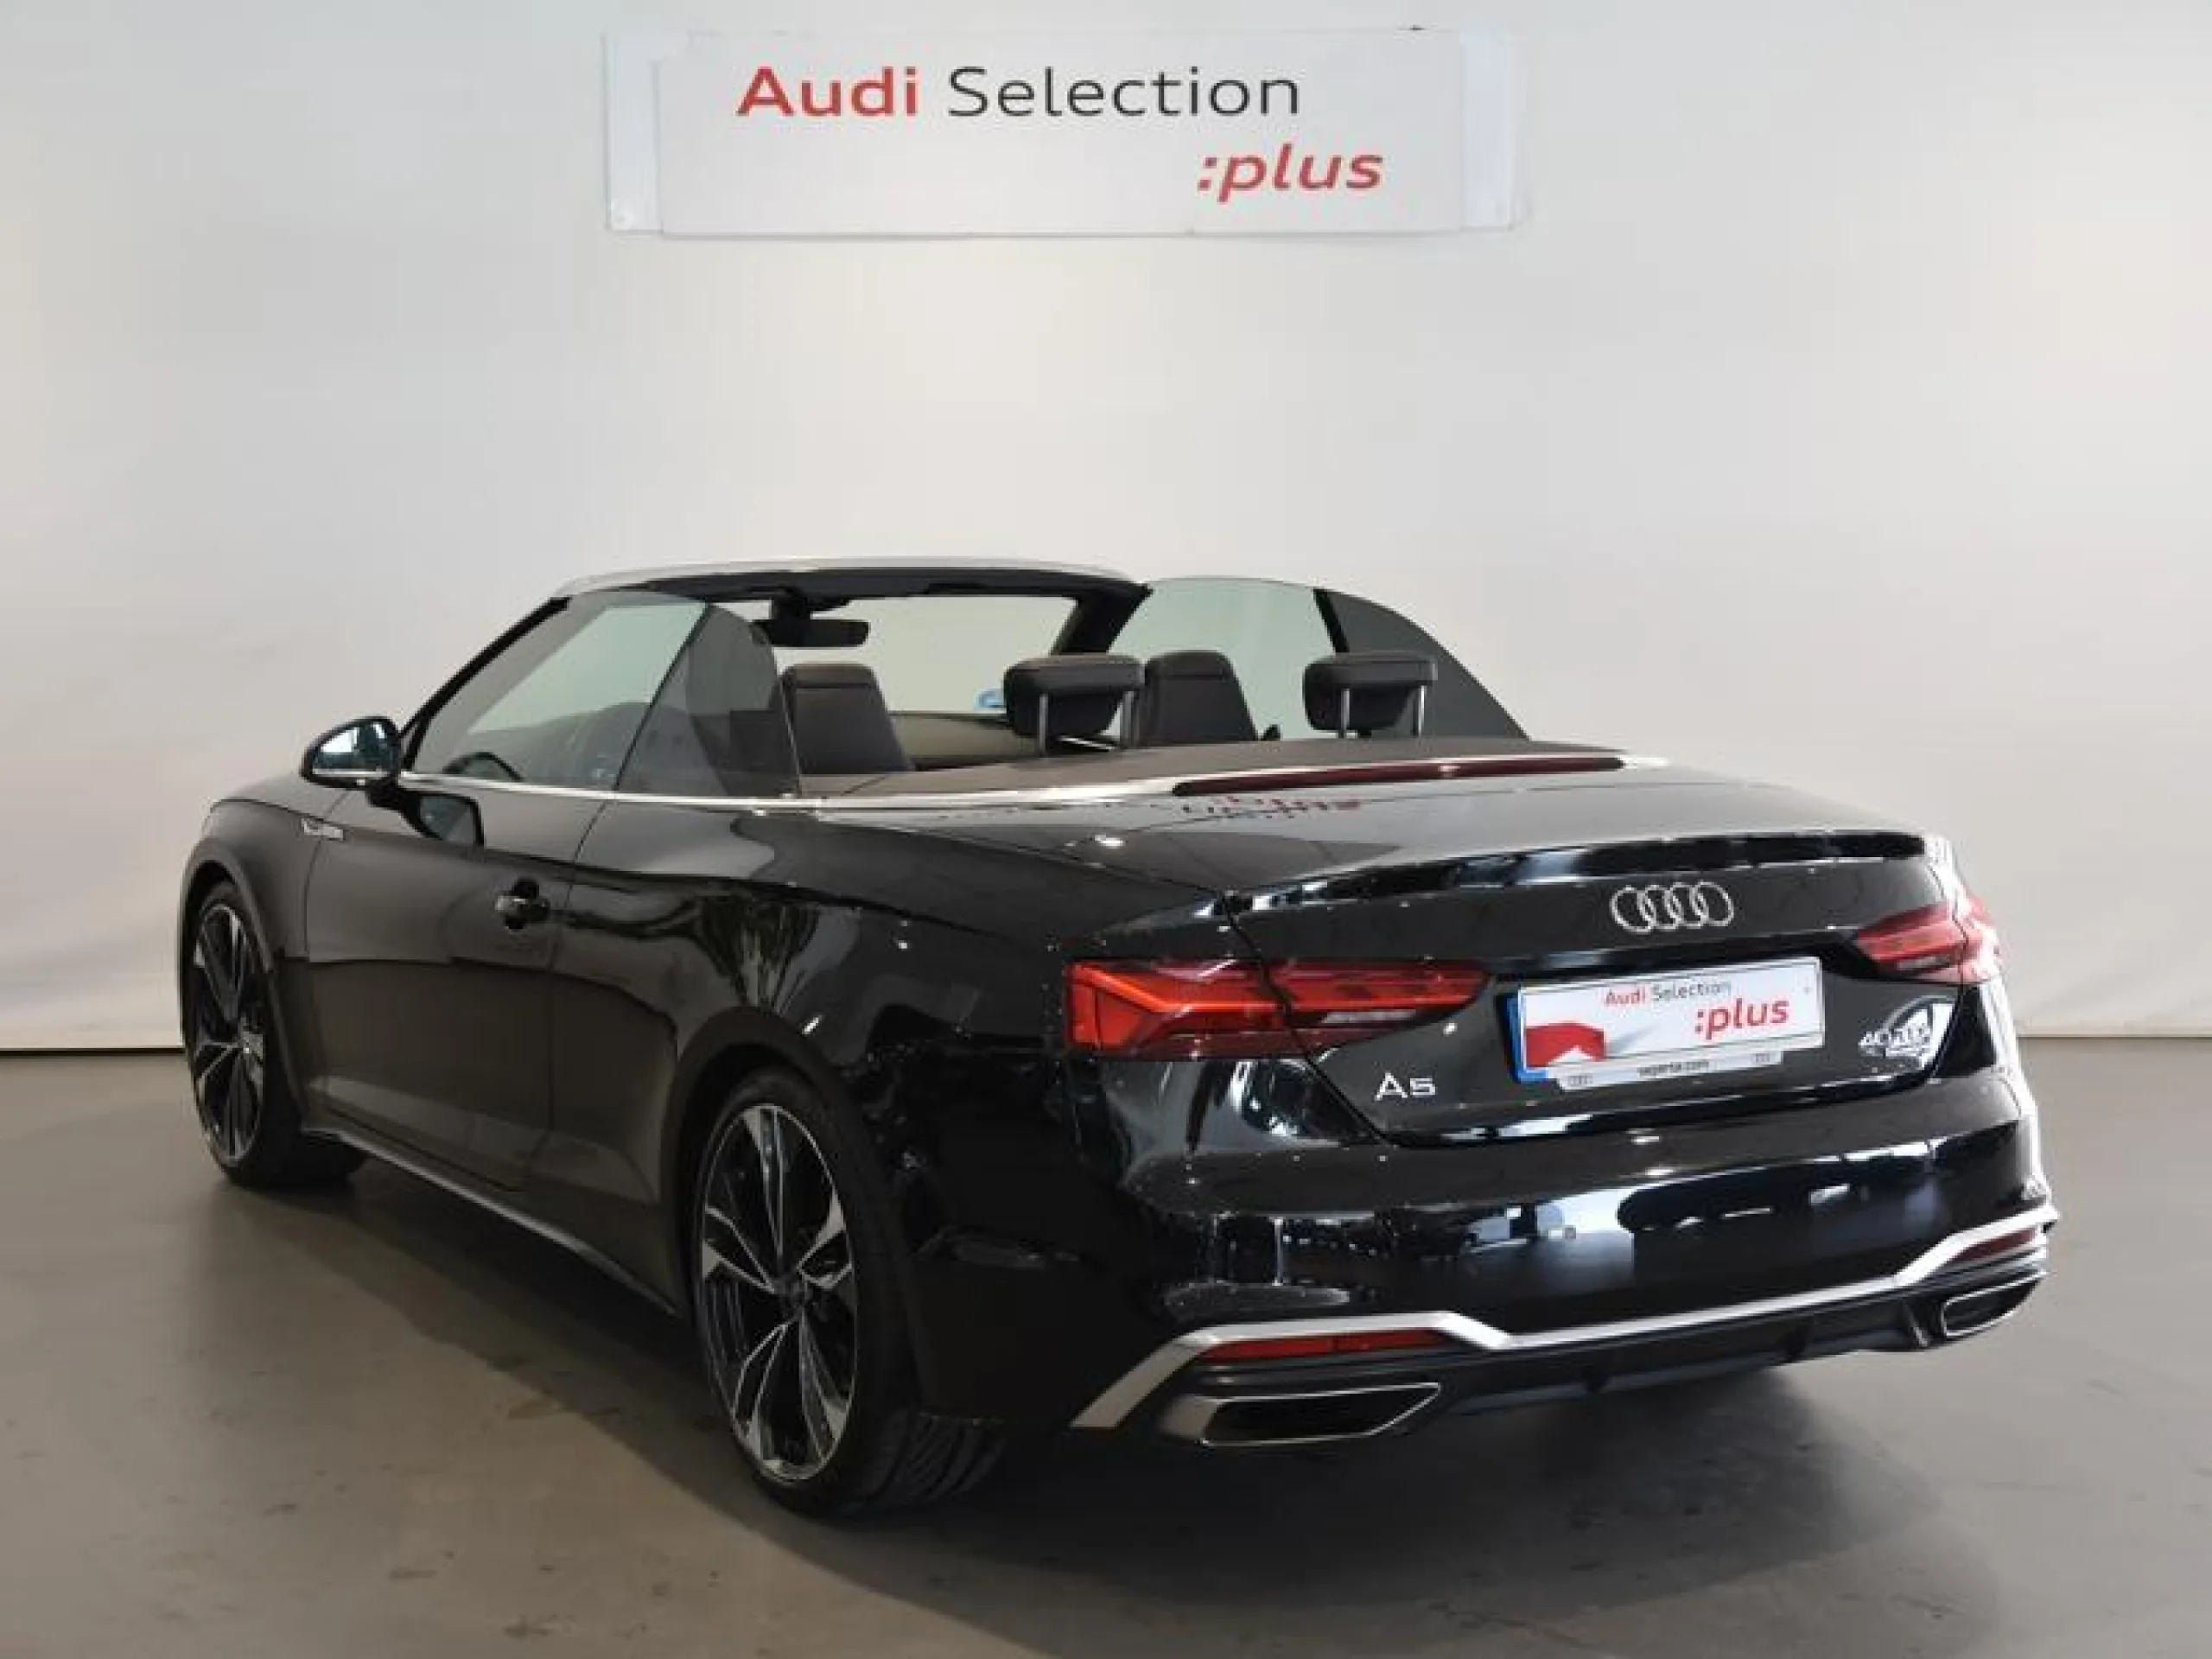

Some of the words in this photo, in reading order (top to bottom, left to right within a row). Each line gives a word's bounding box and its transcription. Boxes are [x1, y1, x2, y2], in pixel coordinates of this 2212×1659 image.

[738, 65, 920, 118] Audi
[948, 65, 1300, 118] Selection
[1197, 143, 1383, 203] :plus
[1605, 987, 1645, 1006] Audi
[1651, 978, 1732, 1001] Selection
[1694, 997, 1789, 1039] :plus
[1375, 1071, 1436, 1102] A5
